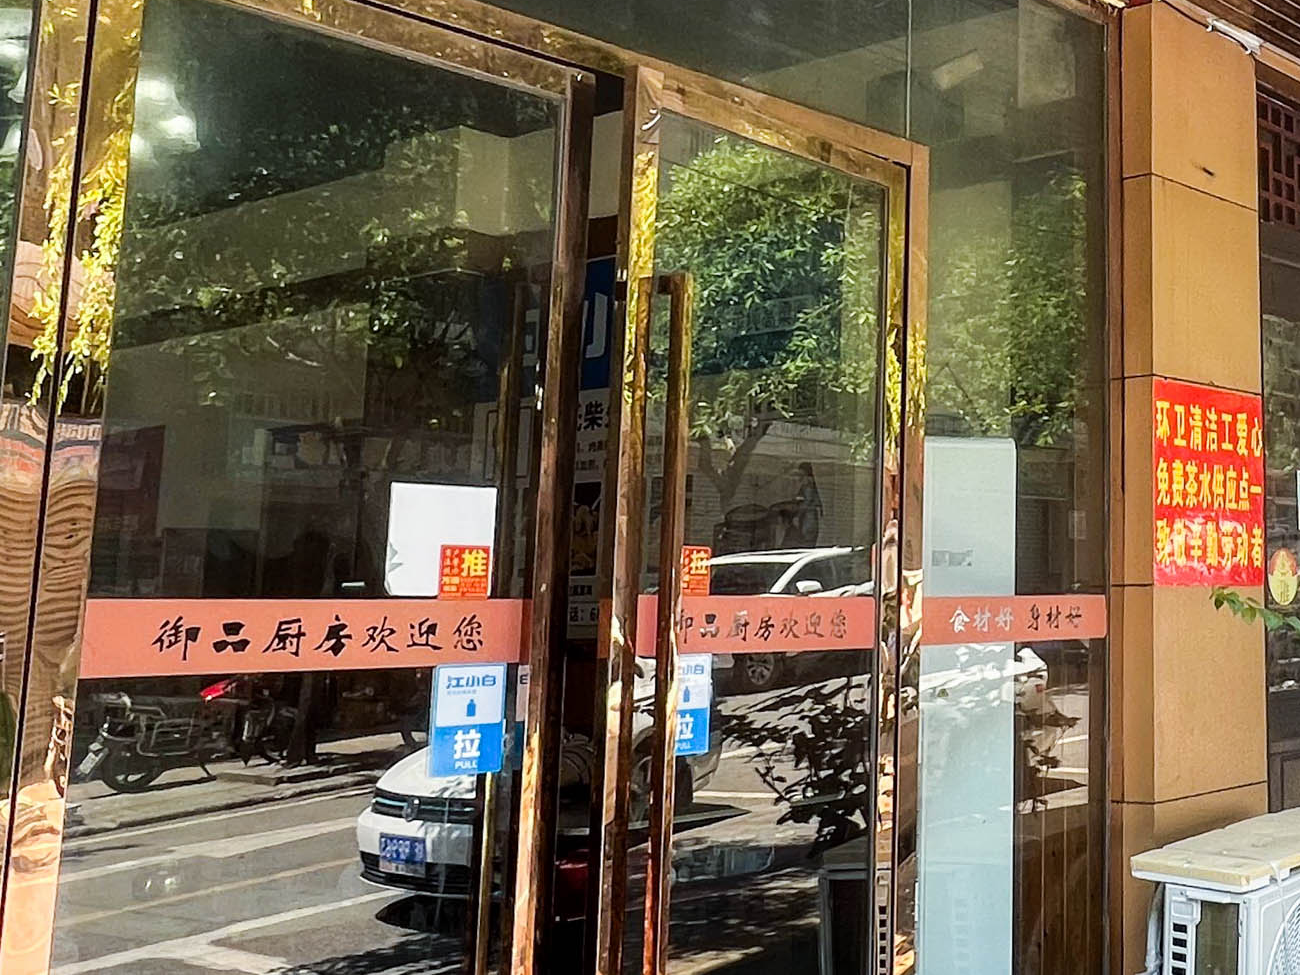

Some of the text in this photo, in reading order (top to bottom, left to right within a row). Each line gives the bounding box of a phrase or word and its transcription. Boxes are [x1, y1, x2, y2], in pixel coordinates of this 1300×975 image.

[1155, 400, 1263, 457] 环卫清洁工爱心
[460, 548, 488, 577] 推
[950, 605, 1014, 633] 食材好
[151, 614, 485, 661] 御品厨房欢迎您
[446, 674, 497, 690] 江小白
[453, 728, 481, 760] 拉
[454, 760, 477, 770] PULL
